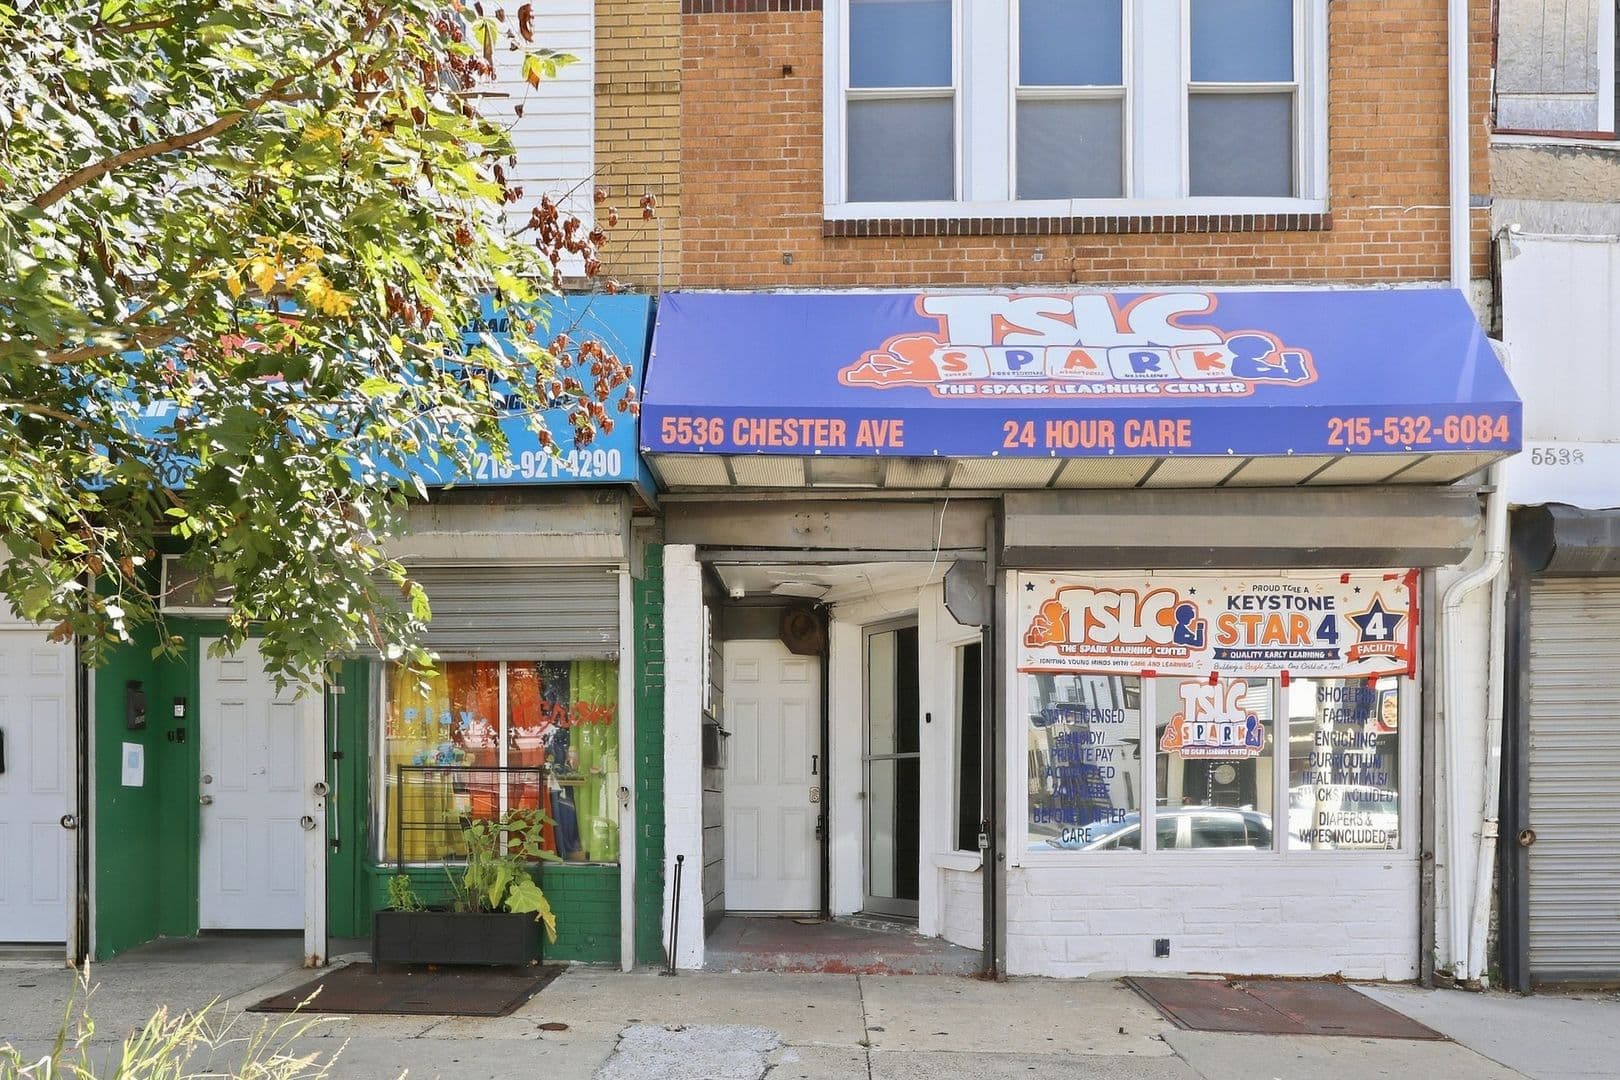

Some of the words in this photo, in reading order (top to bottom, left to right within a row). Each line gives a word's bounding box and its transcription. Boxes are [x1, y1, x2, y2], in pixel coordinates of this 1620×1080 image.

[923, 295, 1222, 347] TSLC
[942, 350, 1225, 373] SPARK
[937, 383, 976, 394] THE
[980, 384, 1050, 395] SPARK
[1055, 384, 1160, 395] LEARNING
[1165, 383, 1247, 394] CENTER
[661, 416, 724, 445] 5536
[732, 417, 847, 446] CHESTER
[855, 419, 904, 448] AVE
[1003, 420, 1036, 449] 24
[1046, 420, 1115, 449] HOUR
[1124, 419, 1192, 448] CARE
[1327, 414, 1510, 446] 215-532-6084
[1531, 447, 1584, 466] 5538
[1252, 584, 1280, 592] PROUD
[1303, 586, 1310, 594] A
[1227, 595, 1335, 611] KEYSTONE
[1058, 589, 1177, 644] TSLC
[1216, 612, 1312, 646] STAR
[1316, 614, 1339, 645] 4
[1365, 612, 1388, 640] 4
[1060, 644, 1077, 653] THE
[1080, 645, 1108, 654] SPARK
[1111, 646, 1153, 655] LEARNING
[1155, 647, 1187, 656] CENTER
[1230, 650, 1263, 660] QUALITY
[1264, 650, 1288, 659] EARLY
[1288, 650, 1325, 659] LEARNING
[1357, 644, 1398, 655] FACILITY
[1180, 683, 1247, 722] TSLC
[1074, 708, 1125, 724] LICENSED
[1315, 731, 1377, 747] ENRICHING
[1095, 748, 1114, 763] PAY
[1319, 811, 1363, 827] DIAPERS
[1365, 813, 1373, 827] &
[1061, 828, 1092, 844] CARE
[1299, 829, 1333, 844] WIPES
[1335, 829, 1386, 844] INCLUDED
